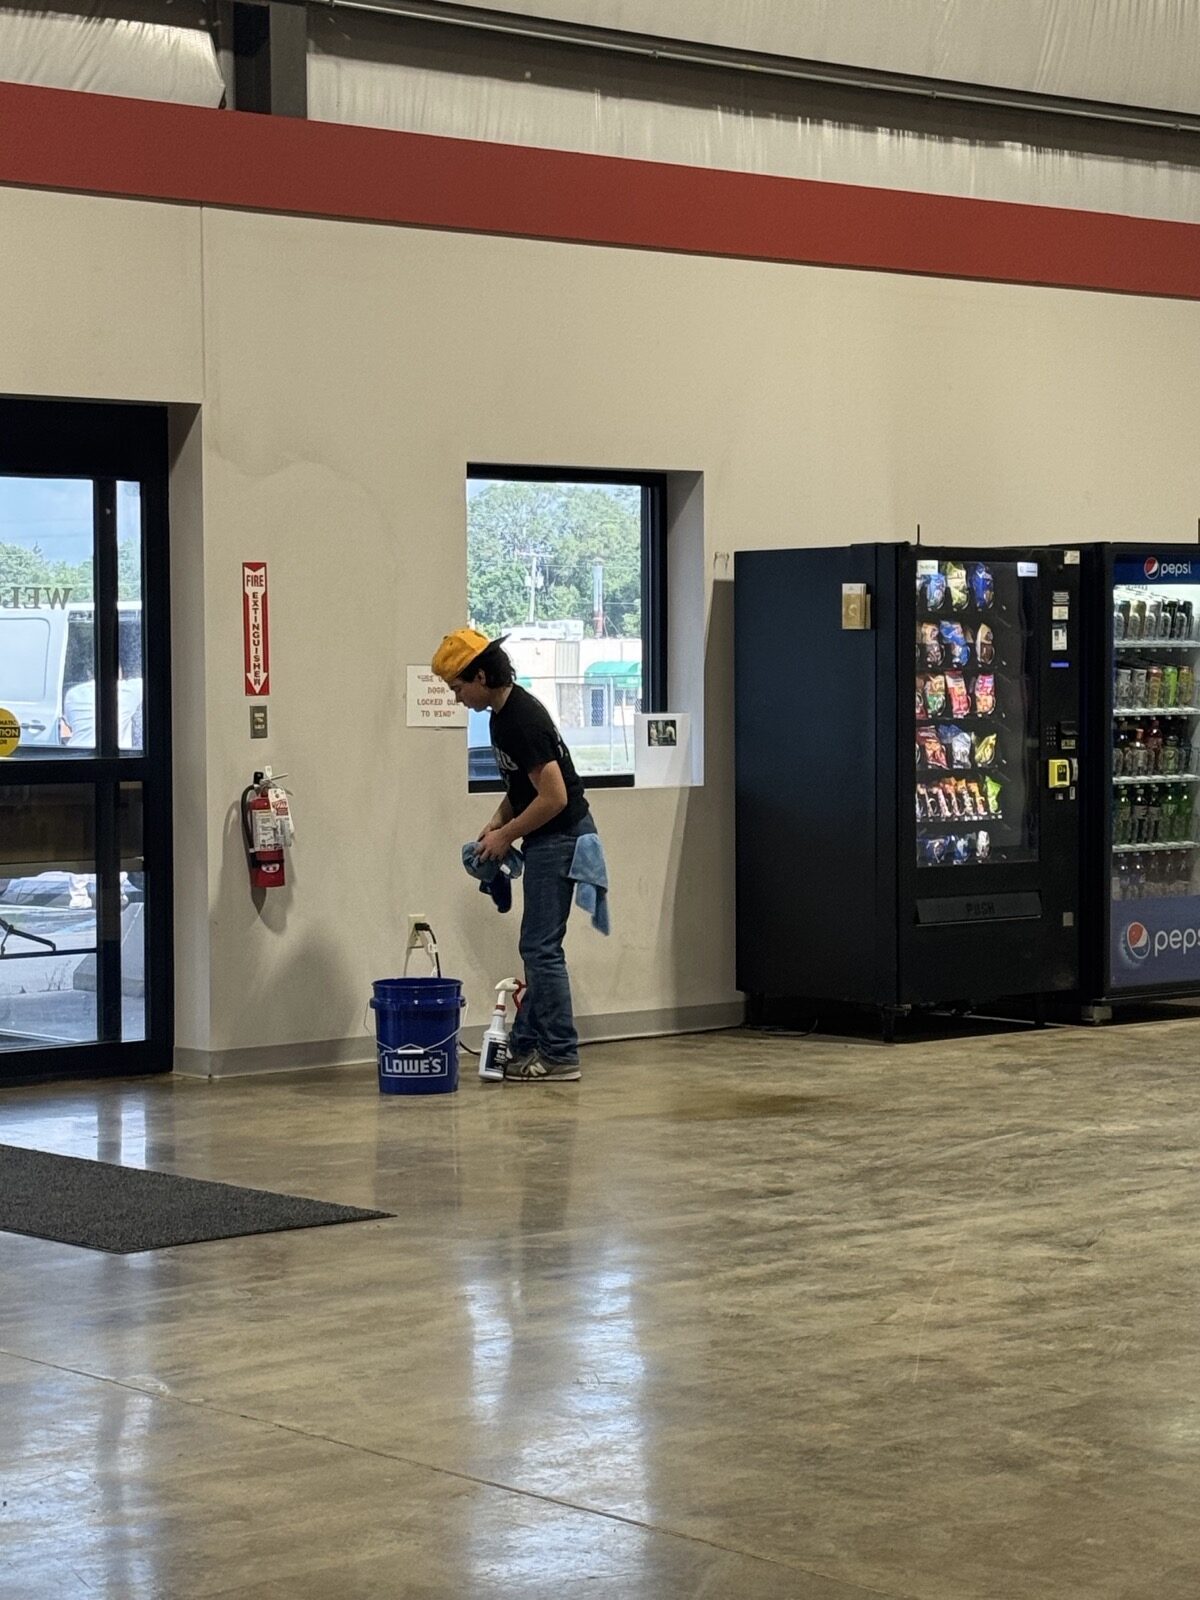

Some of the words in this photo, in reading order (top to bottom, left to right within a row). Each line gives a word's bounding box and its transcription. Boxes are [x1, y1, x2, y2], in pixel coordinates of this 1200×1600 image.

[1161, 561, 1191, 576] pepsi
[246, 574, 264, 587] FIRE
[251, 591, 261, 686] EXTINGUISHER
[966, 902, 995, 916] PUSH
[385, 1055, 442, 1074] LOWE'S
